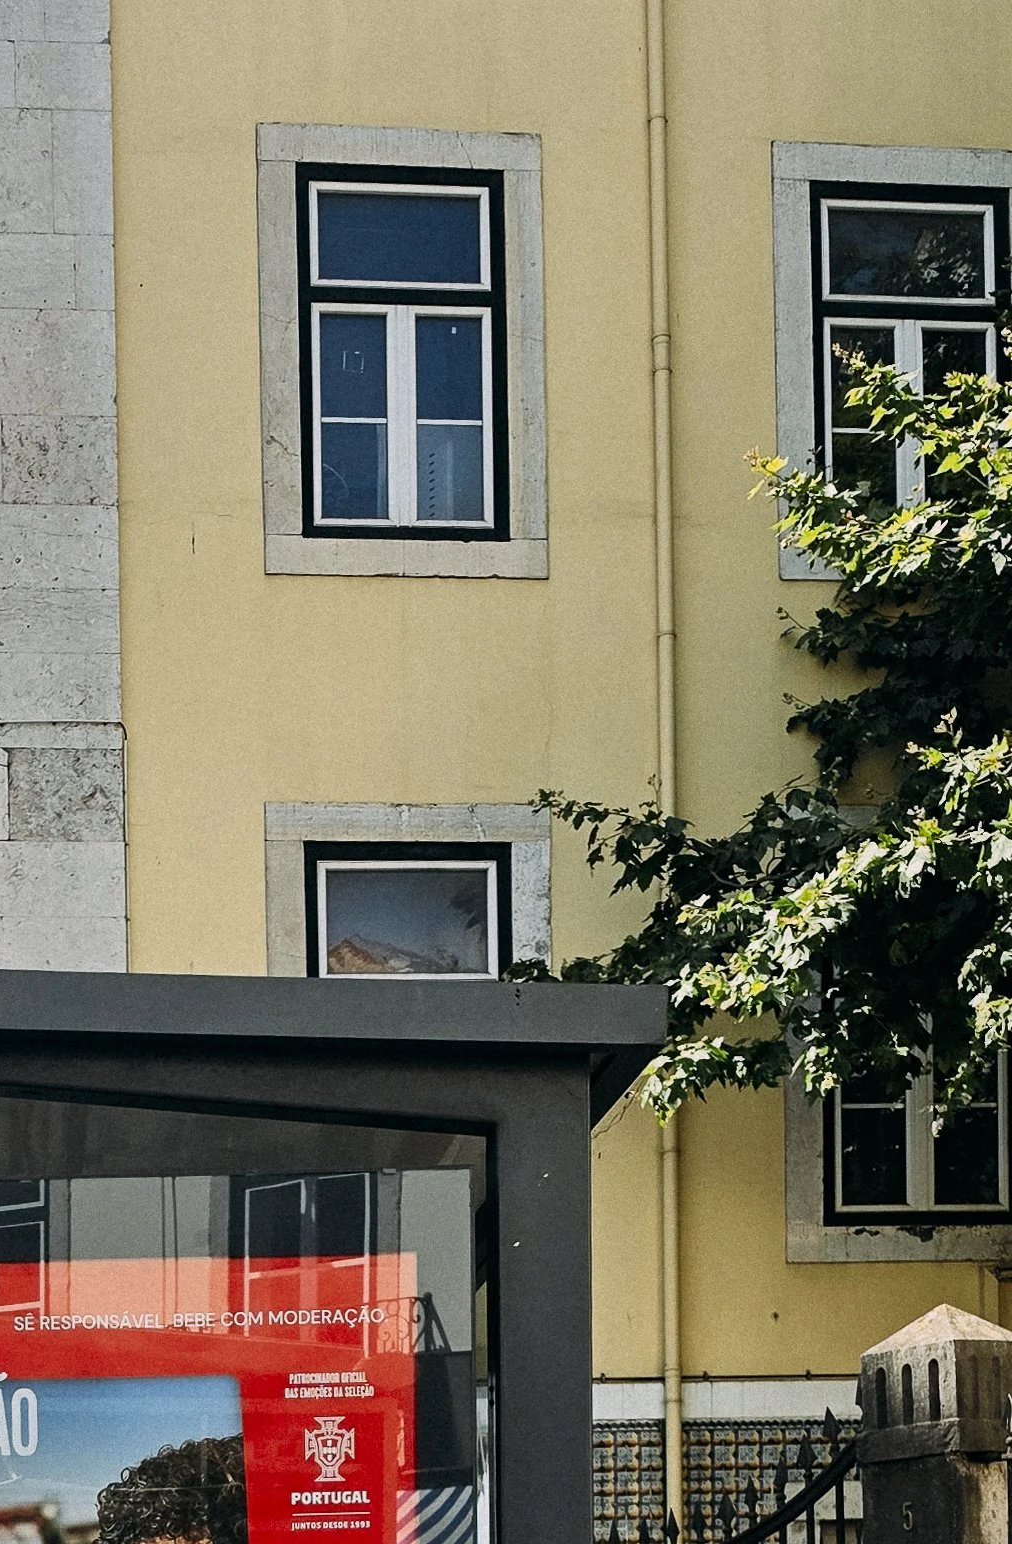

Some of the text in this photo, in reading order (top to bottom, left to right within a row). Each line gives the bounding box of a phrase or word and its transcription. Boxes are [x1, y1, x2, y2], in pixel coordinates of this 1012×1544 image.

[14, 1313, 36, 1331] SÊ
[173, 1312, 215, 1327] BEBE
[220, 1311, 263, 1326] COM
[289, 1371, 367, 1384] PATROCINADOR OFICIAL
[284, 1383, 375, 1399] DAS EMOÇÕES DA SELEÇÃO
[291, 1491, 370, 1505] PORTUGAL
[902, 1502, 913, 1530] 5
[291, 1521, 321, 1531] JUNTOS
[323, 1521, 348, 1529] DESDE
